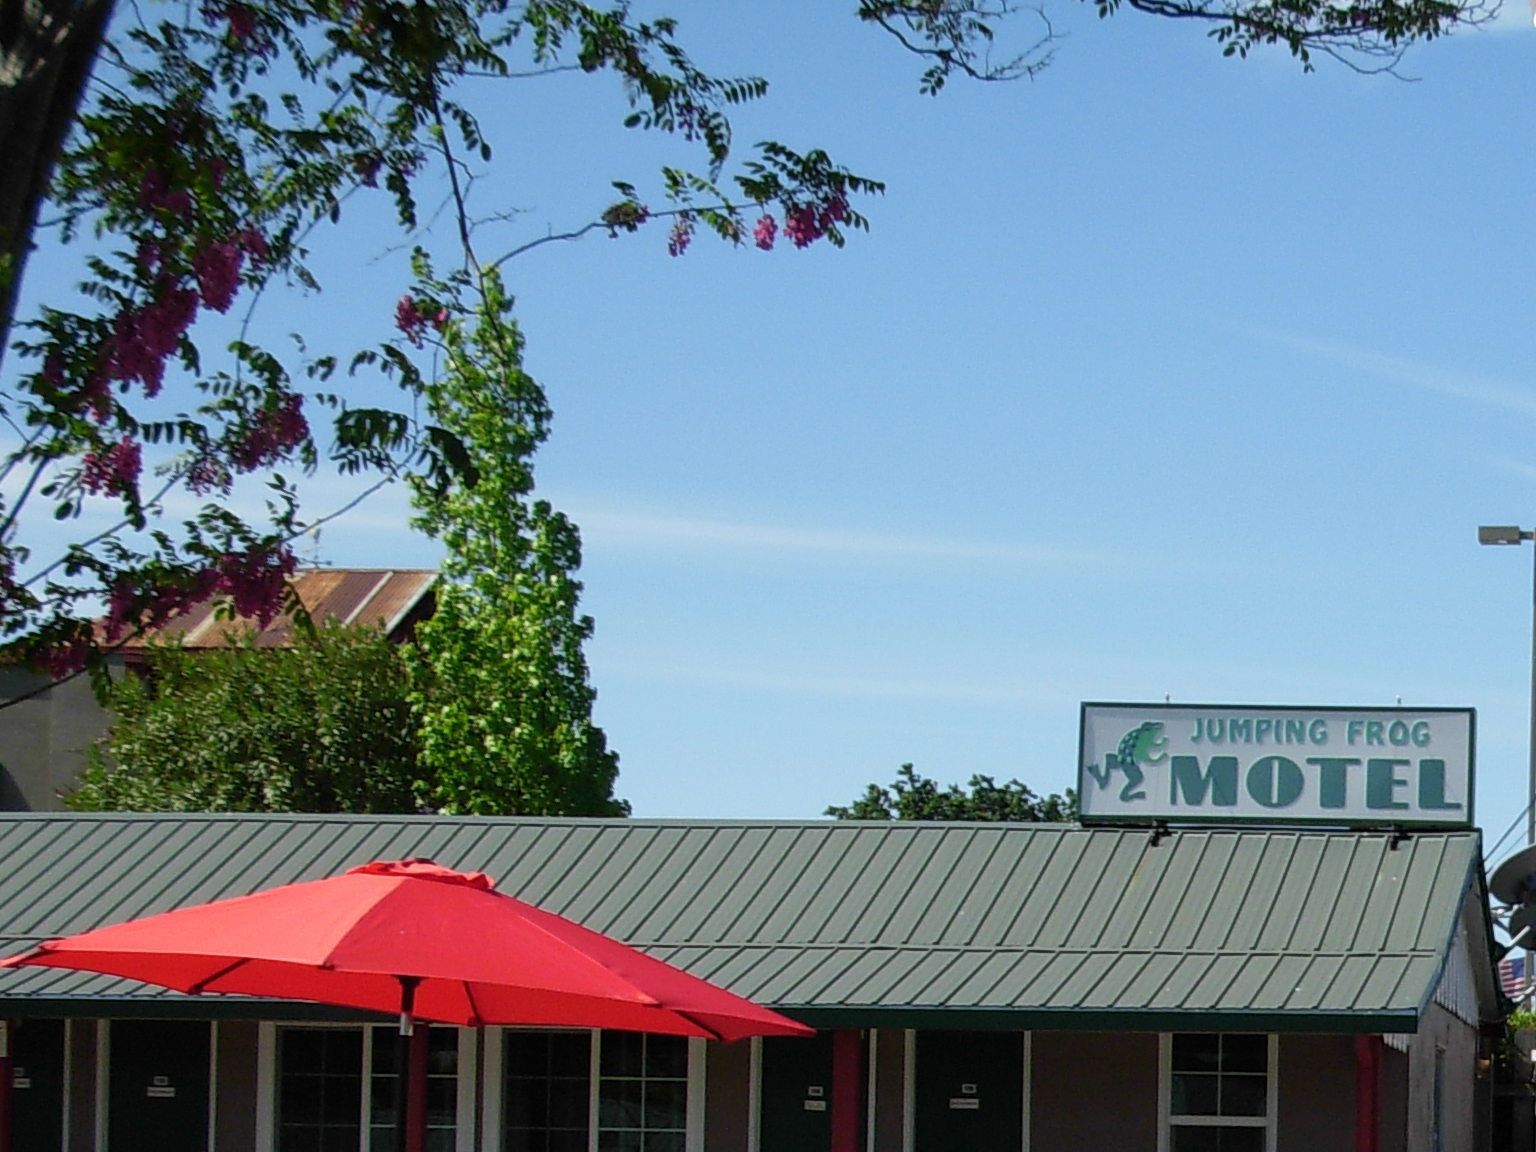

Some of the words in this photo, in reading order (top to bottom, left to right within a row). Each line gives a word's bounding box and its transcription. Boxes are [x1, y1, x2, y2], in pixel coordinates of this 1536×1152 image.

[1190, 716, 1329, 746] JUMPING
[1346, 718, 1432, 747] FROG
[1170, 754, 1463, 811] MOTEL
